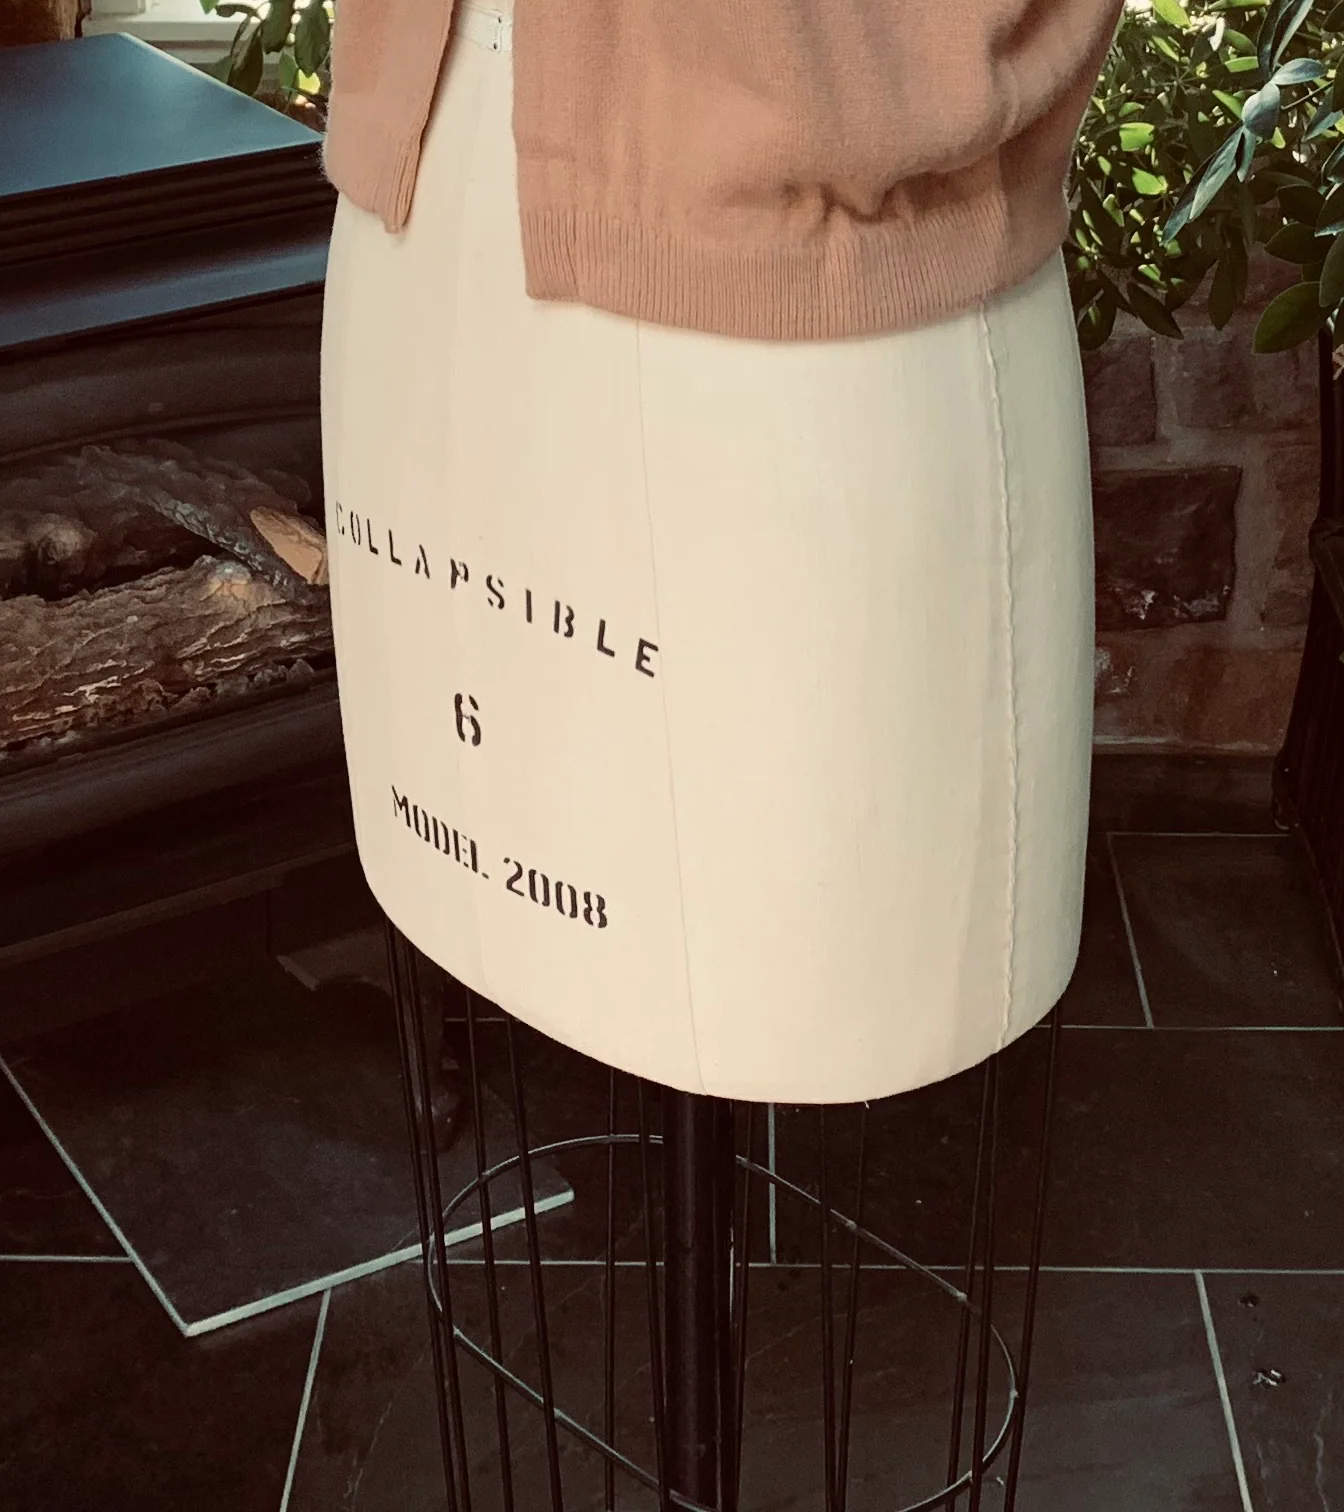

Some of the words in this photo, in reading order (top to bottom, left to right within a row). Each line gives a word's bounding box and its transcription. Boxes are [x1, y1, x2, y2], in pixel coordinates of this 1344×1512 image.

[335, 500, 659, 678] COLLAPSIBLE
[453, 692, 482, 747] 6
[391, 784, 490, 880] MODEL
[502, 856, 608, 929] 2008
